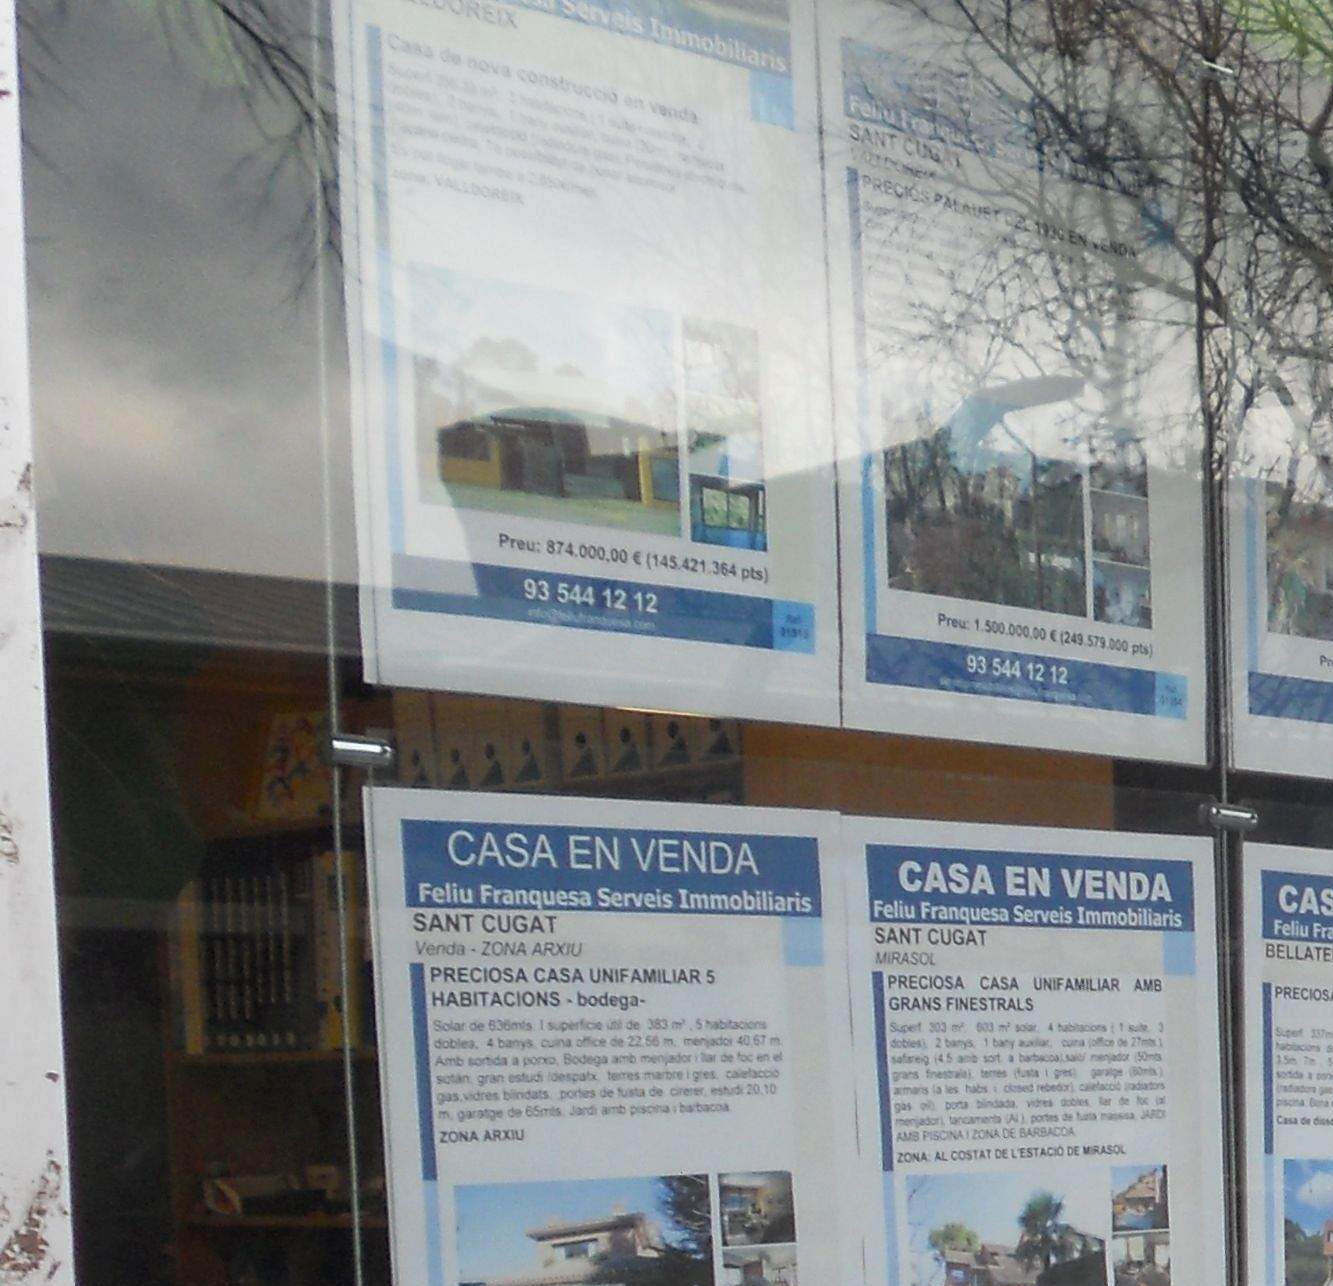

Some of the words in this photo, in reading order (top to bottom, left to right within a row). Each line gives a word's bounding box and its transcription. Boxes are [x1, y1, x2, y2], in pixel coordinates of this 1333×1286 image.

[651, 22, 787, 72] Immobiliaris
[499, 534, 540, 552] Preu:
[632, 550, 642, 565] €
[645, 552, 736, 579] (145.421.364
[741, 563, 768, 585] pts)
[524, 578, 551, 601] 93
[557, 582, 595, 606] 544
[600, 587, 626, 610] 12
[634, 591, 657, 613] 12
[938, 614, 971, 631] Preu:
[1050, 628, 1057, 641] €
[1060, 629, 1129, 652] (249.579.000
[1132, 638, 1153, 656] pts)
[448, 831, 555, 869] CASA
[570, 836, 618, 871] EN
[631, 838, 759, 875] VENDA
[899, 861, 995, 895] CASA
[1006, 866, 1049, 897] EN
[1061, 868, 1172, 901] VENDA
[419, 883, 470, 903] Feliu
[481, 884, 591, 911] Franquesa
[598, 887, 672, 908] Serveis
[680, 889, 811, 912] Immobiliaris
[414, 914, 473, 933] SANT
[482, 914, 556, 933] CUGAT
[875, 952, 935, 966] MIRASOL
[431, 968, 525, 983] PRECIOSA
[534, 968, 583, 983] CASA
[591, 969, 700, 984] UNIFAMILIAR
[707, 970, 715, 984] 5
[888, 976, 964, 990] PRECIOSA
[980, 977, 1018, 991] CASA
[1034, 978, 1119, 992] UNIFAMILIAR
[1135, 979, 1162, 992] AMB
[889, 998, 942, 1011] GRANS
[947, 998, 1034, 1011] FINESTRALS
